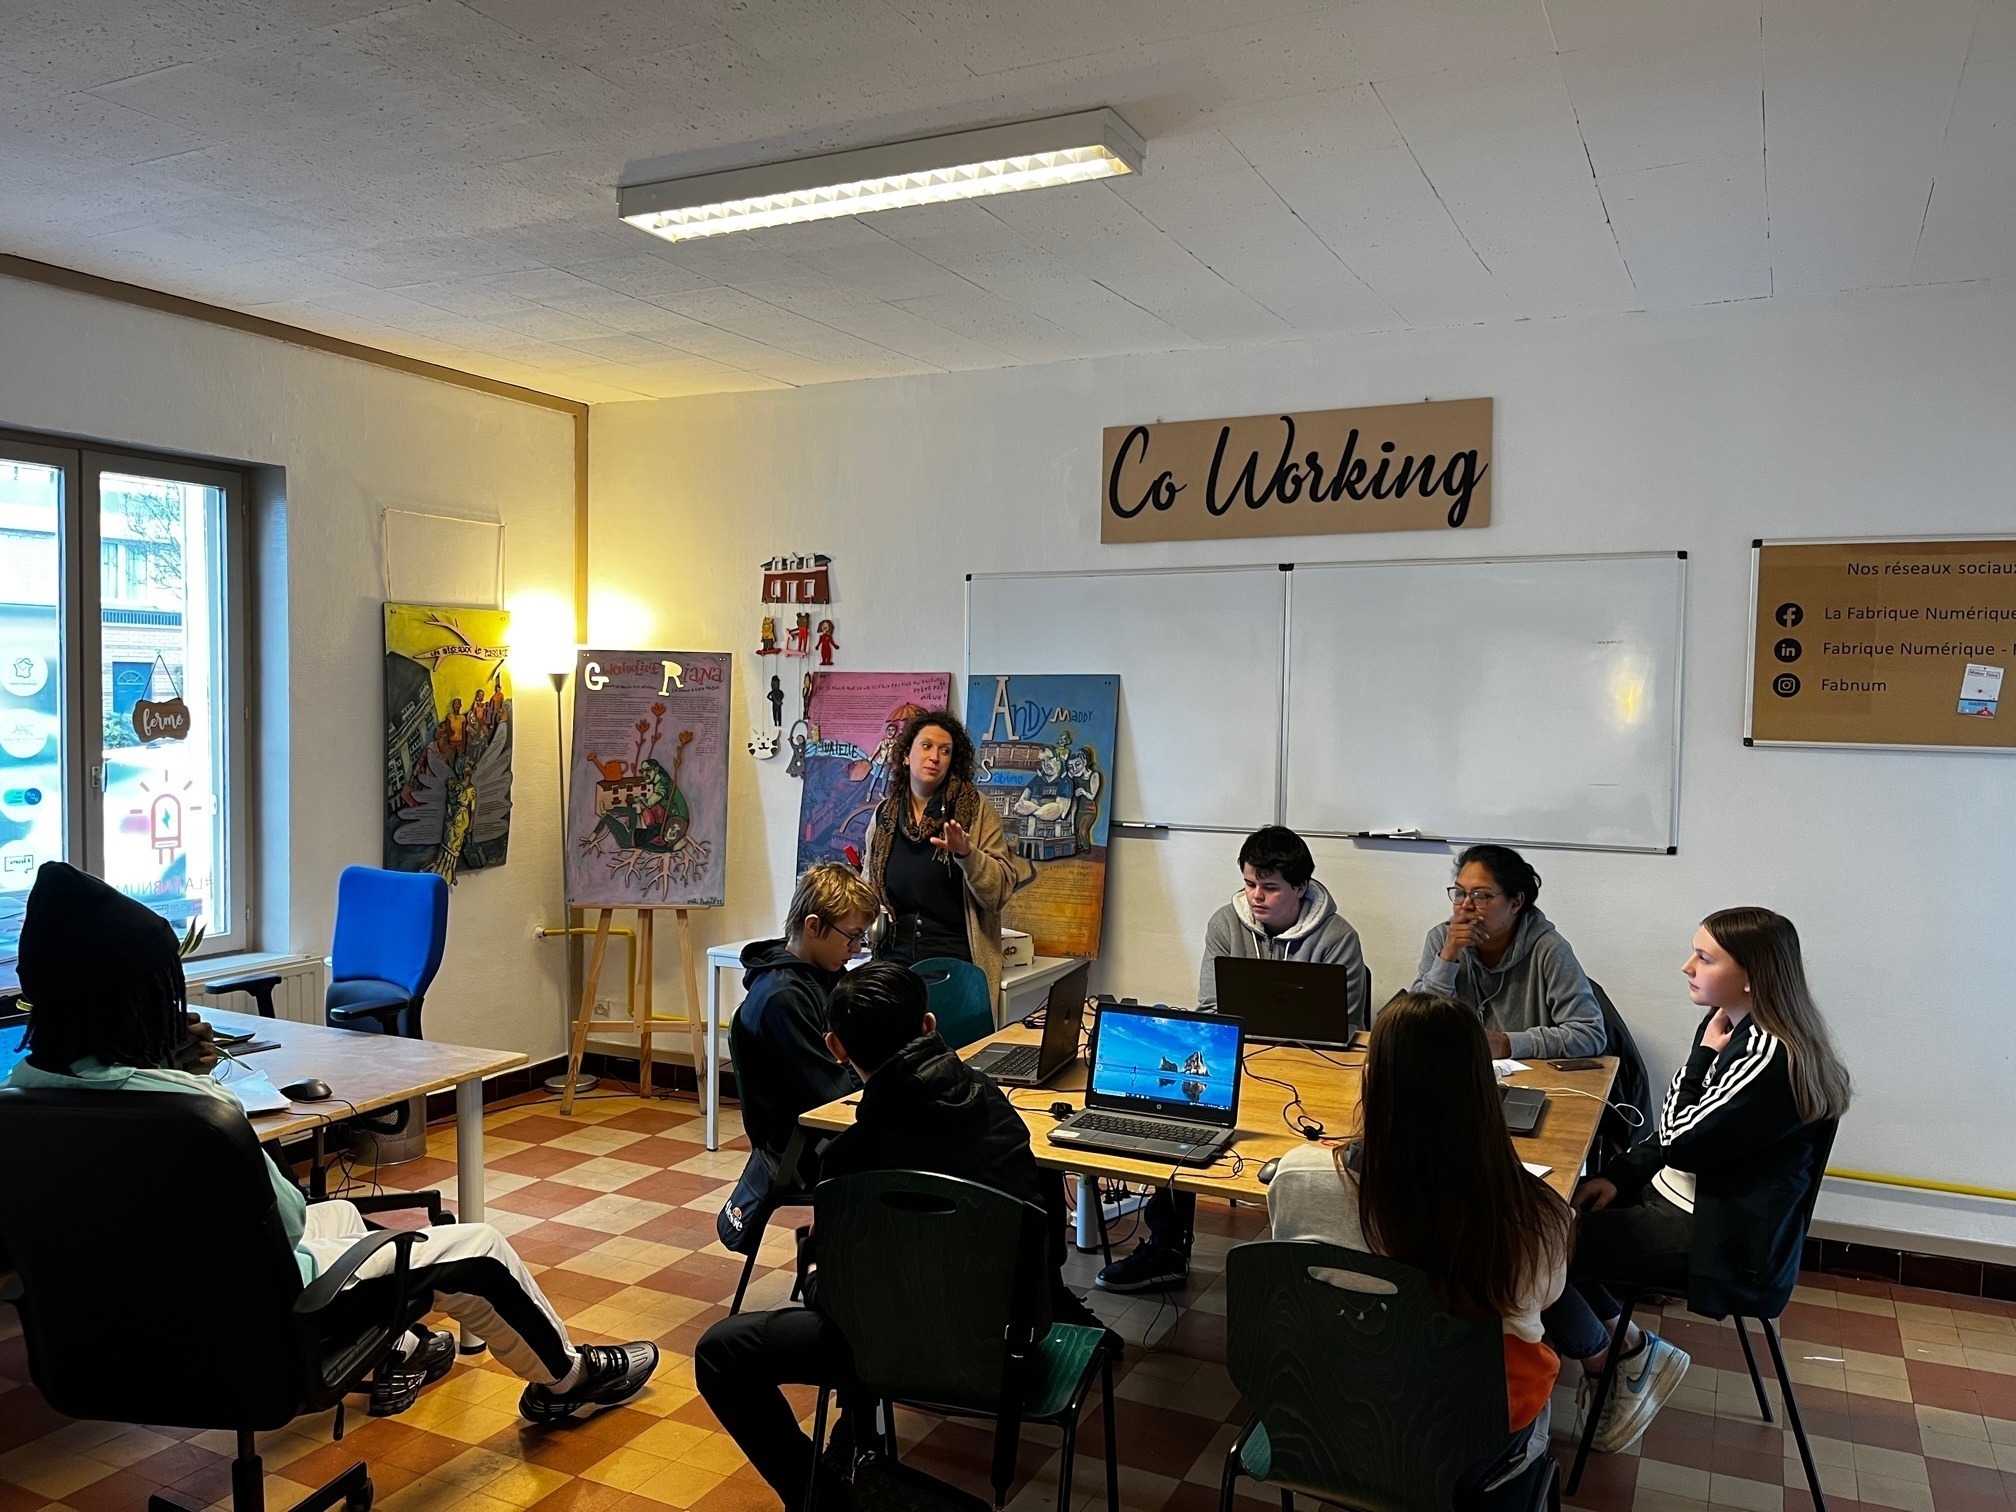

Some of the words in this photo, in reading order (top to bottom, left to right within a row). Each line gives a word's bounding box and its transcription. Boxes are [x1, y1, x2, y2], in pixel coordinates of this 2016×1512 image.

[1108, 426, 1187, 519] Co
[1205, 415, 1489, 528] Working
[1847, 563, 1879, 576] Nos
[1884, 562, 1951, 575] réseaux
[1958, 561, 2016, 575] sociau
[1825, 607, 1842, 620] La
[1847, 606, 1919, 622] Fabrique
[1823, 642, 1894, 658] Fabrique
[1900, 642, 1995, 658] Numérique
[1821, 678, 1887, 692] Fabnum
